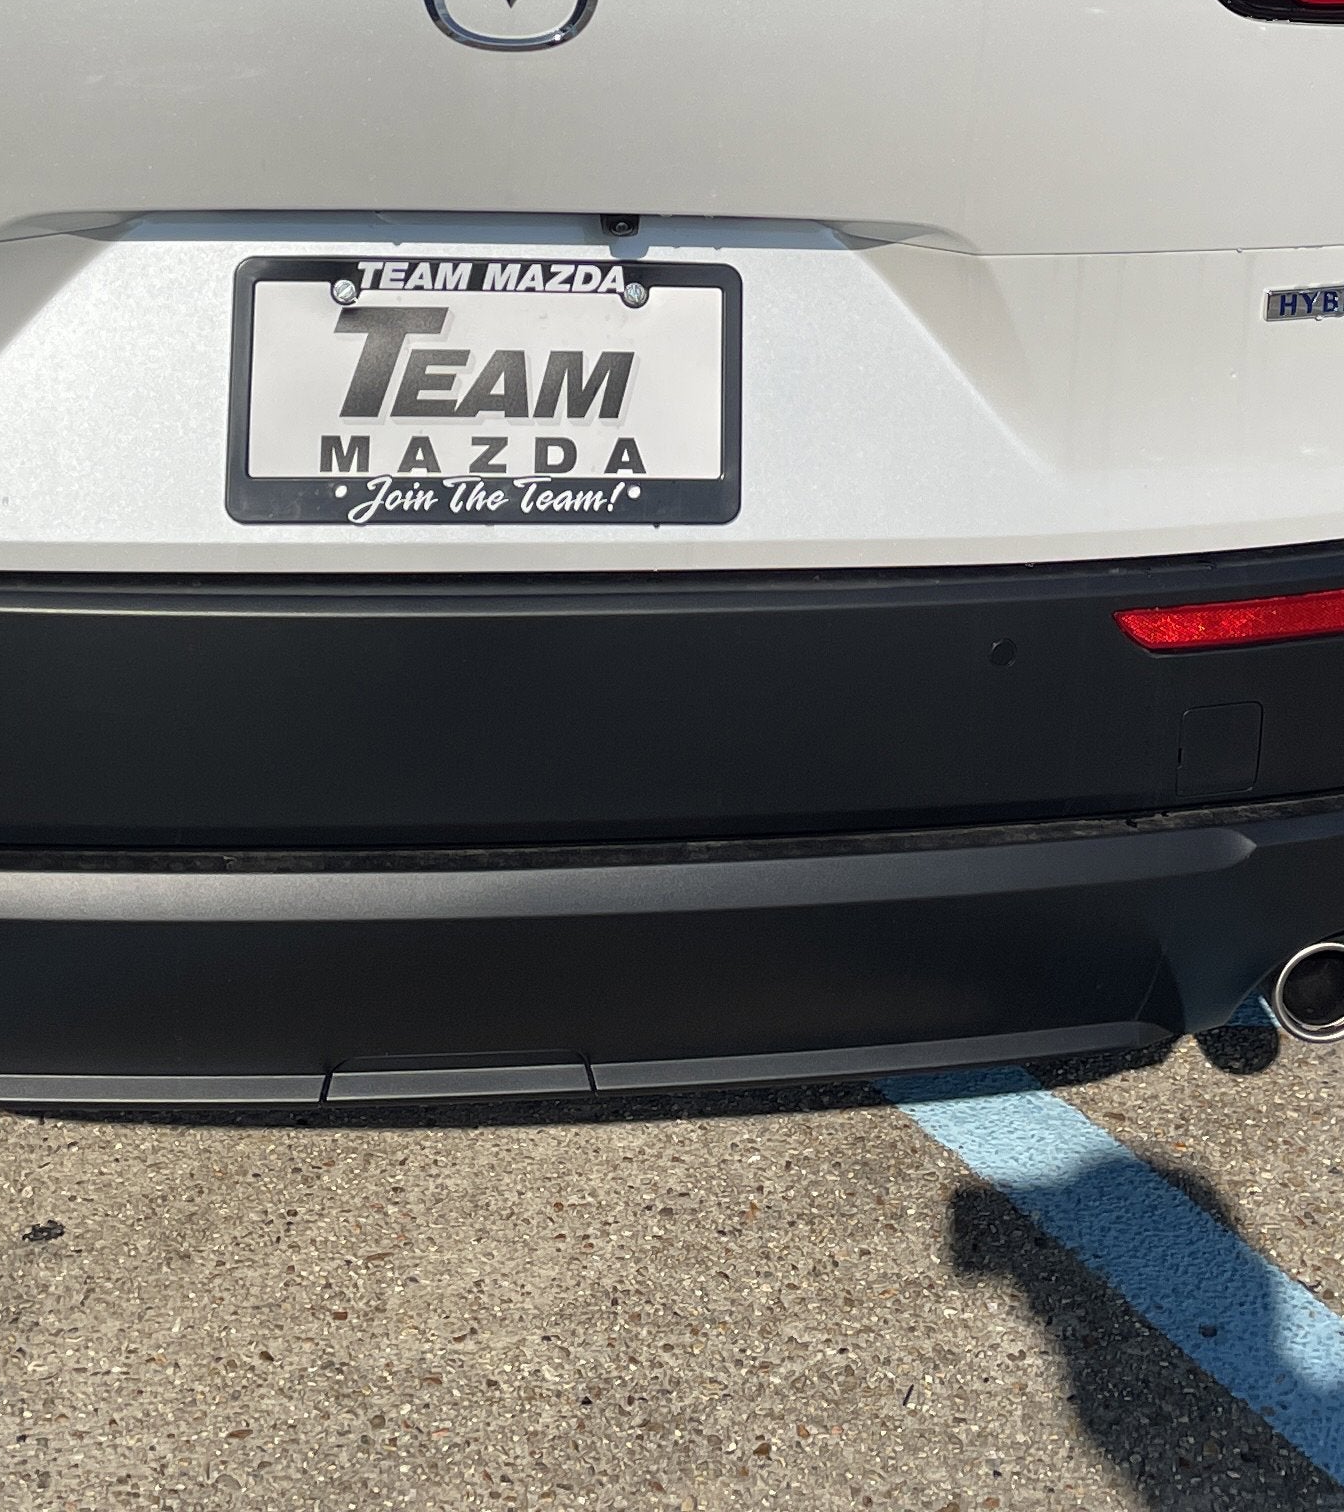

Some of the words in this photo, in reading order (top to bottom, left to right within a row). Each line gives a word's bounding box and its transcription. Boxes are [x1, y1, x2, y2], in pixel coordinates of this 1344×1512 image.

[358, 261, 473, 291] TEAM
[482, 263, 625, 294] MAZDA
[334, 306, 636, 420] TEAM
[319, 435, 647, 475] MAZDA
[347, 475, 438, 525] Join
[440, 476, 510, 513] The
[511, 476, 622, 514] Team!
